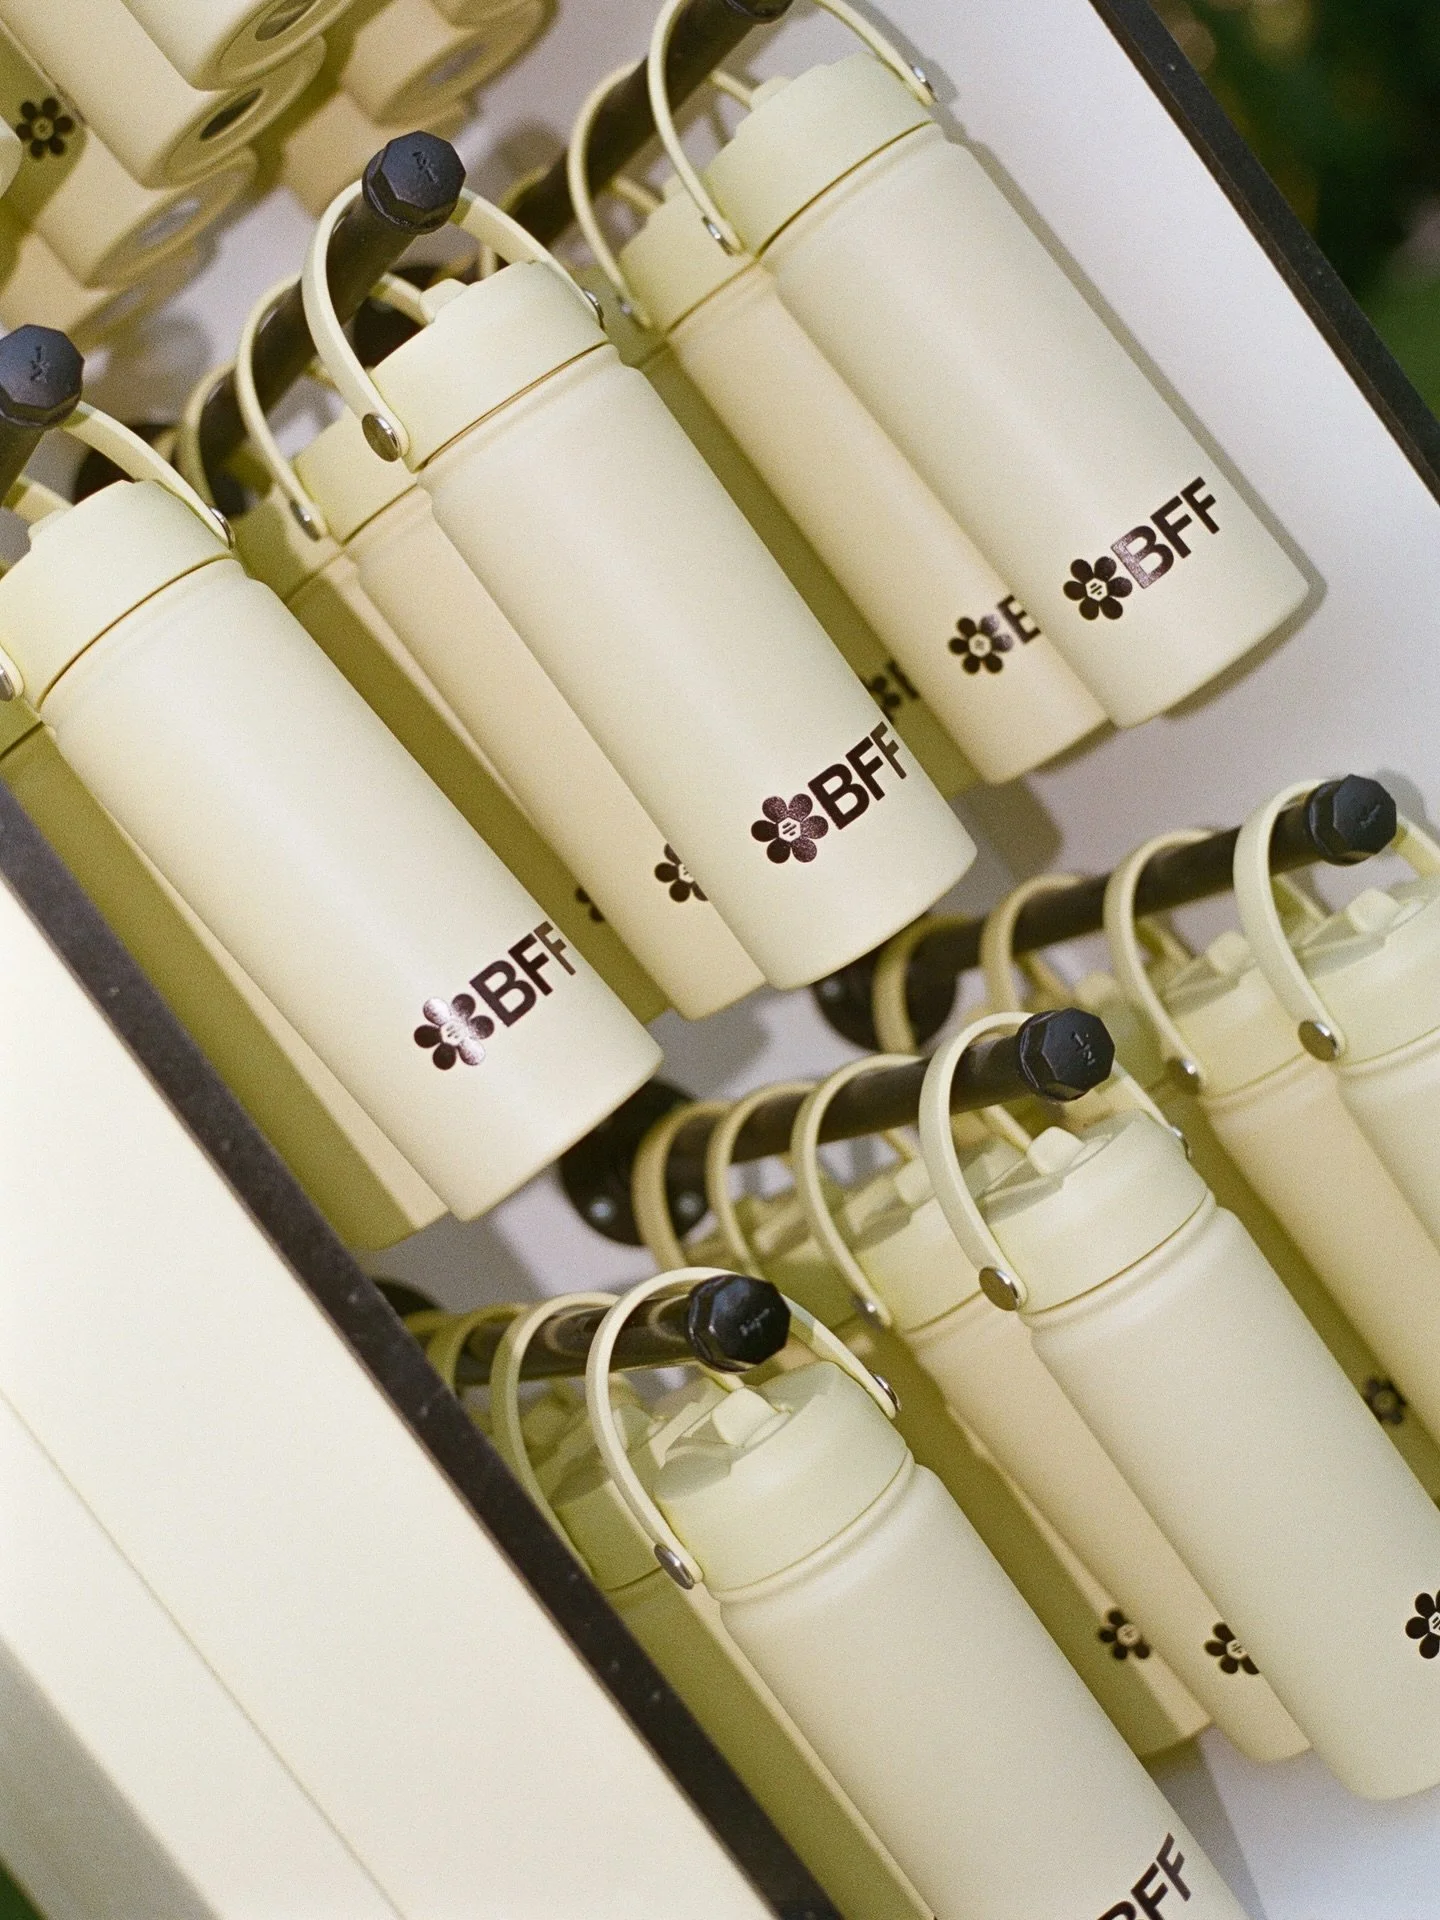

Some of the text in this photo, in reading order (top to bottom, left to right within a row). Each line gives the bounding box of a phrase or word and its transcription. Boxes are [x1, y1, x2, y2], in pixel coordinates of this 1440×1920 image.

[1110, 476, 1220, 589] BFF
[807, 721, 907, 830] BFF
[469, 920, 576, 1027] BFF
